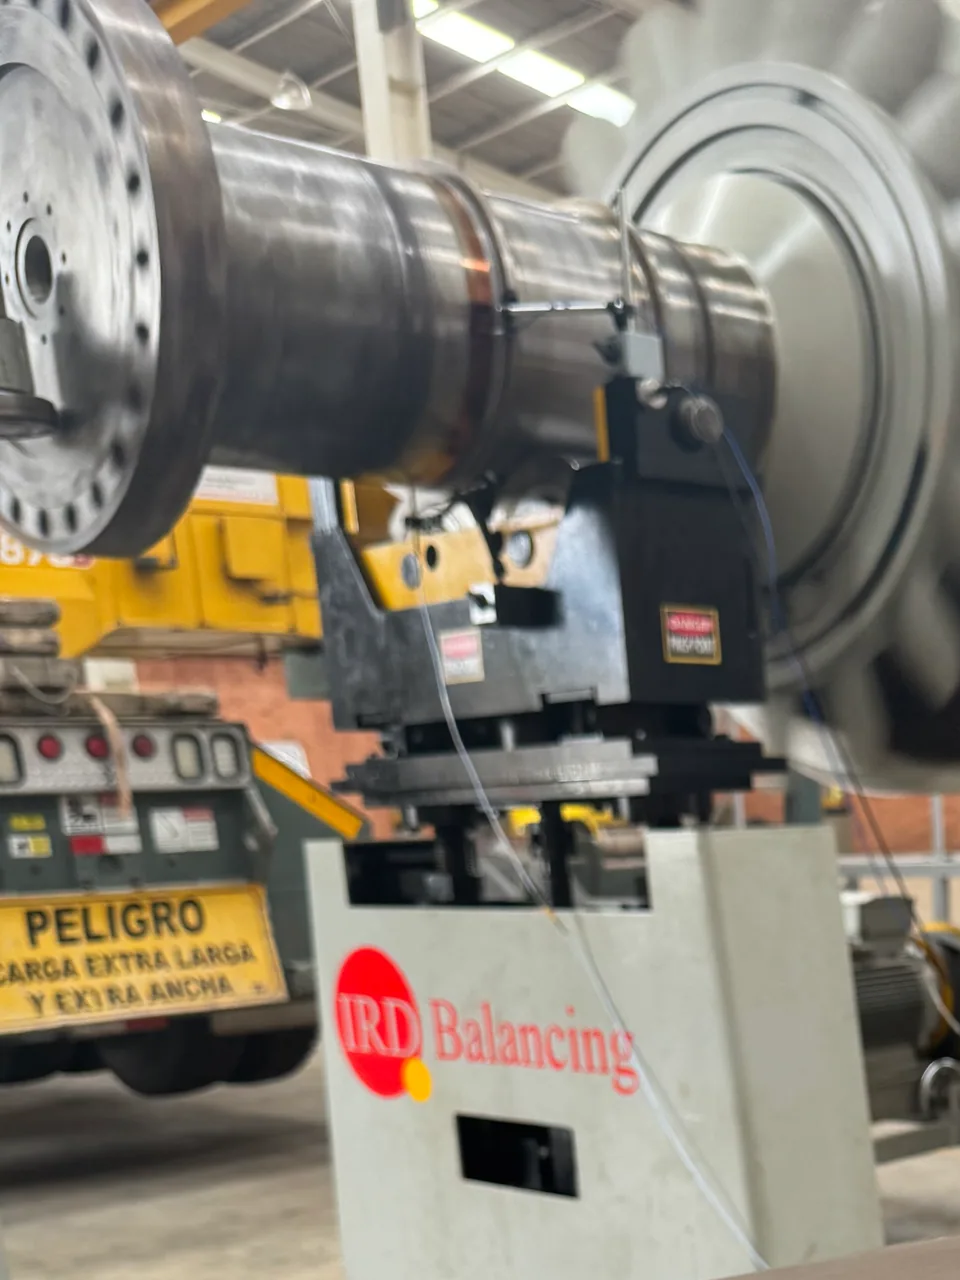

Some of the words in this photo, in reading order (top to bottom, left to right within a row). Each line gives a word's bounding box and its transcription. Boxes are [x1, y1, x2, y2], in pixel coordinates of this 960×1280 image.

[26, 898, 205, 948] PELIGRO
[86, 947, 169, 978] EXTRA
[177, 942, 256, 966] LARGA
[28, 992, 45, 1014] Y
[56, 983, 141, 1013] EXTRA
[150, 974, 235, 1002] ANCHA
[336, 993, 422, 1059] IRD
[429, 998, 640, 1095] Balancing
